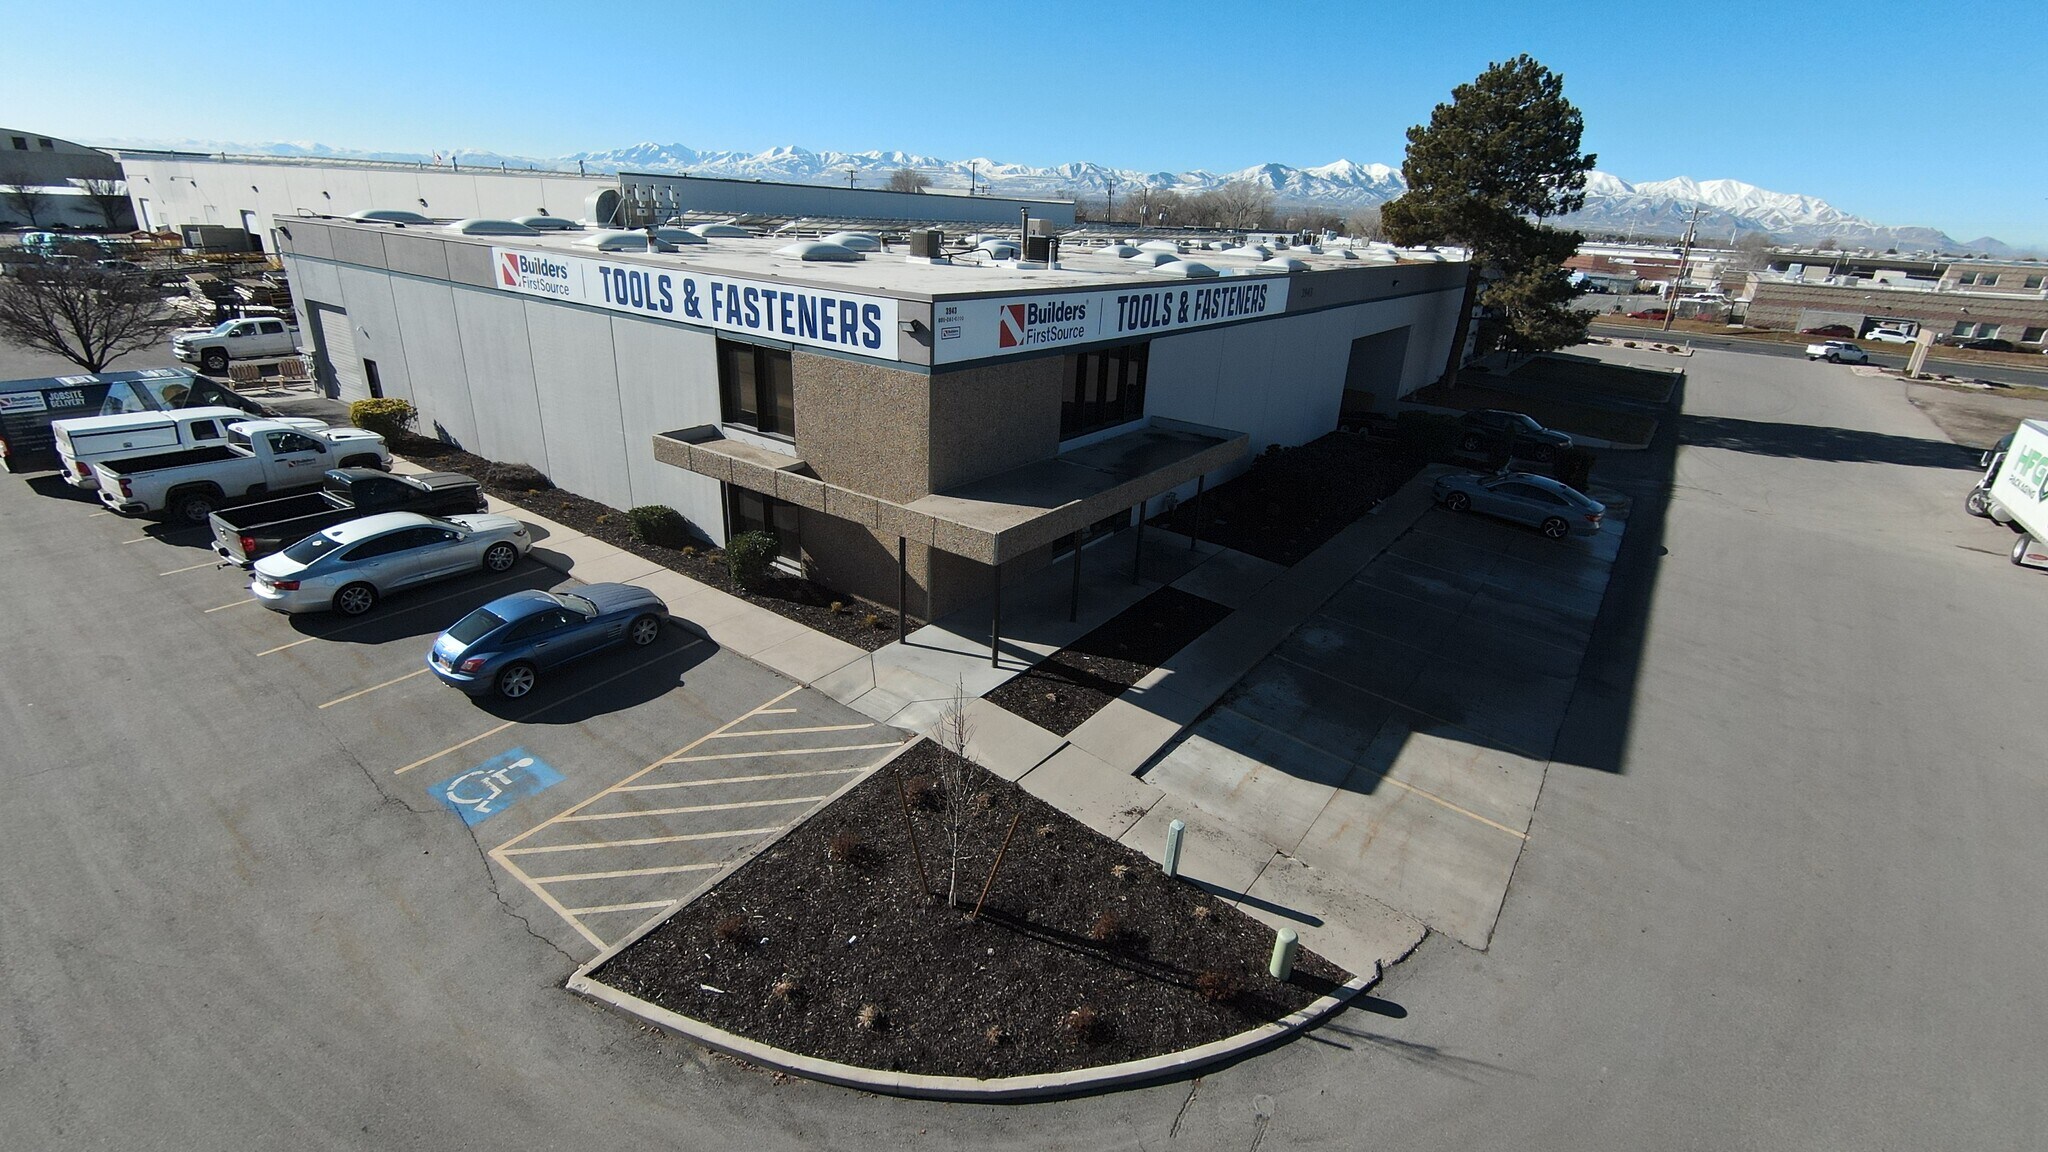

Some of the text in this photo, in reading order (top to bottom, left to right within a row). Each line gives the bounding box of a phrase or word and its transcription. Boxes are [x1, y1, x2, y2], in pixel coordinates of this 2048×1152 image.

[520, 255, 567, 279] Builders
[522, 276, 569, 295] FirstSource
[599, 266, 881, 349] TOOLS & FASTENERS
[1028, 301, 1086, 325] Builders
[1118, 284, 1267, 332] TOOLS & FASTENERS
[1027, 326, 1085, 344] FirstSource
[49, 390, 84, 401] JOBSITE
[50, 398, 85, 408] DELIVERY
